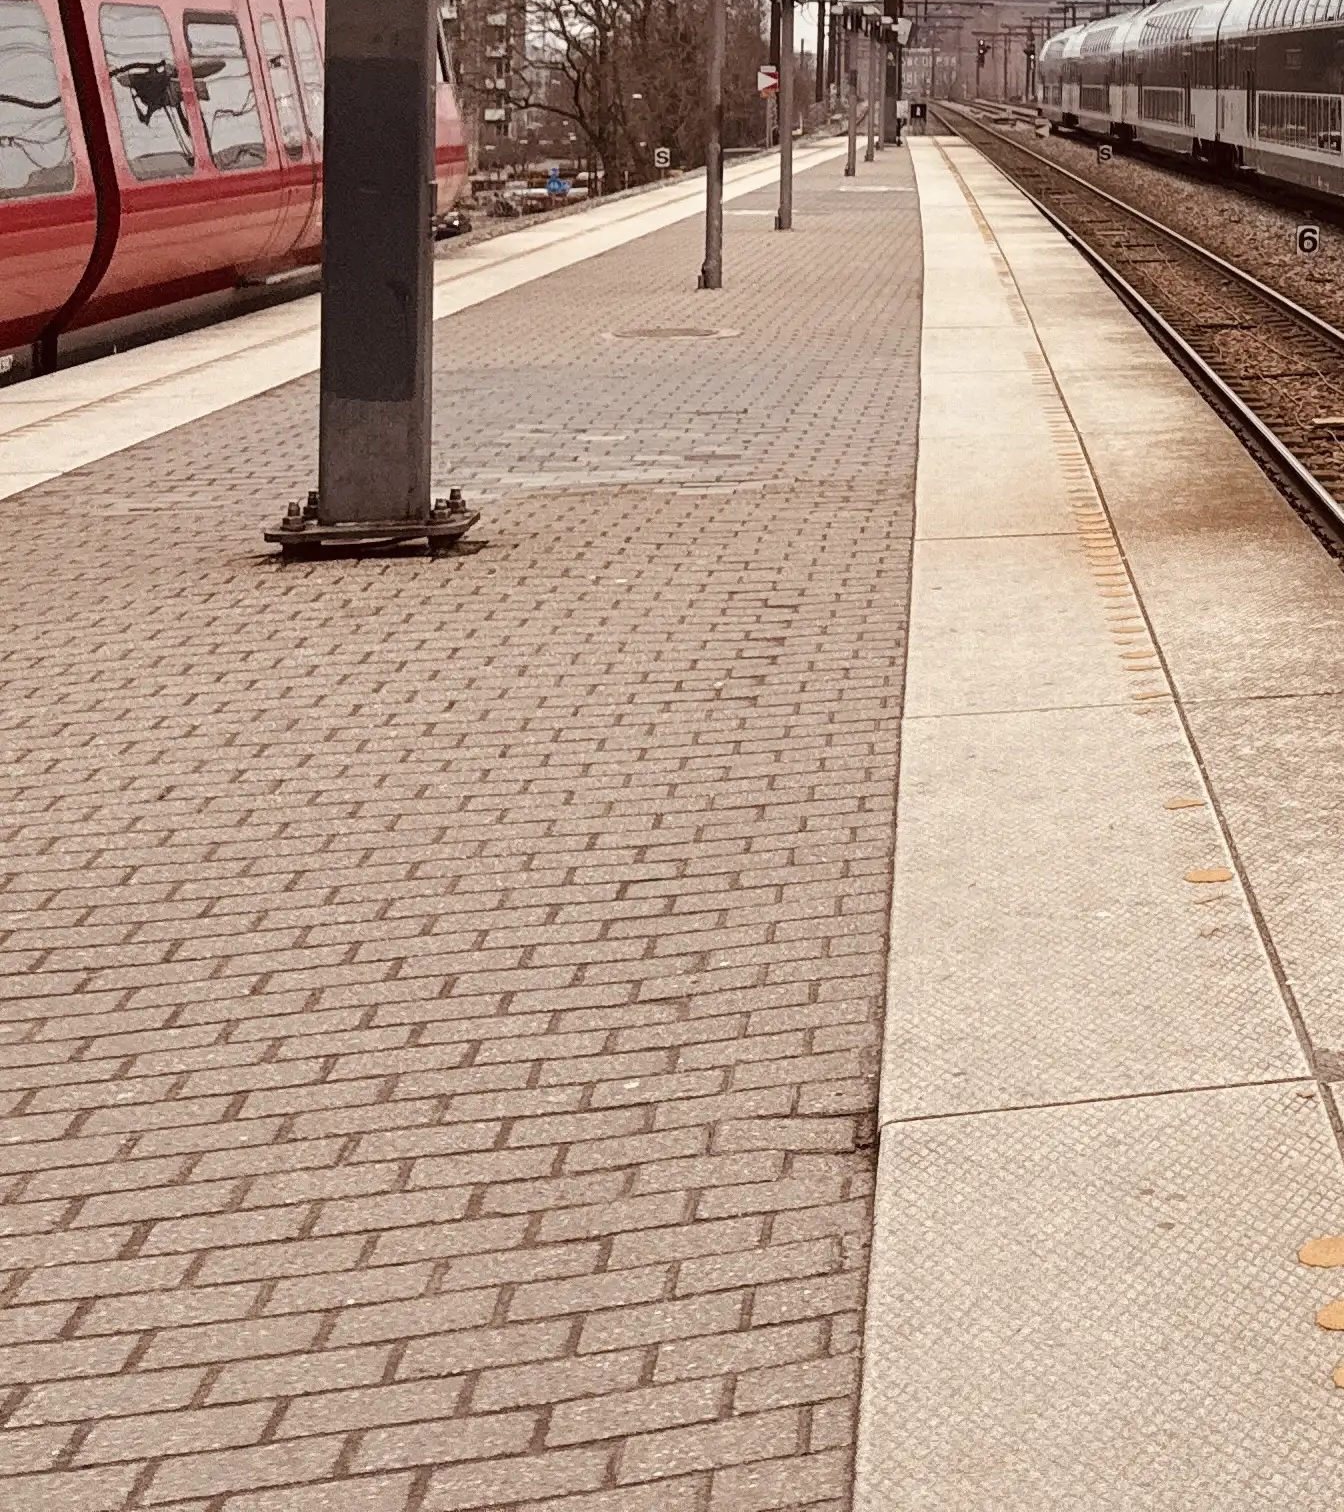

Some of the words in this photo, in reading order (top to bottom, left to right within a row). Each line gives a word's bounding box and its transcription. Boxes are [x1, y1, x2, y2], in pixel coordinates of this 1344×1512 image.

[656, 150, 669, 164] S
[1100, 147, 1111, 160] S
[1298, 227, 1318, 253] 6
